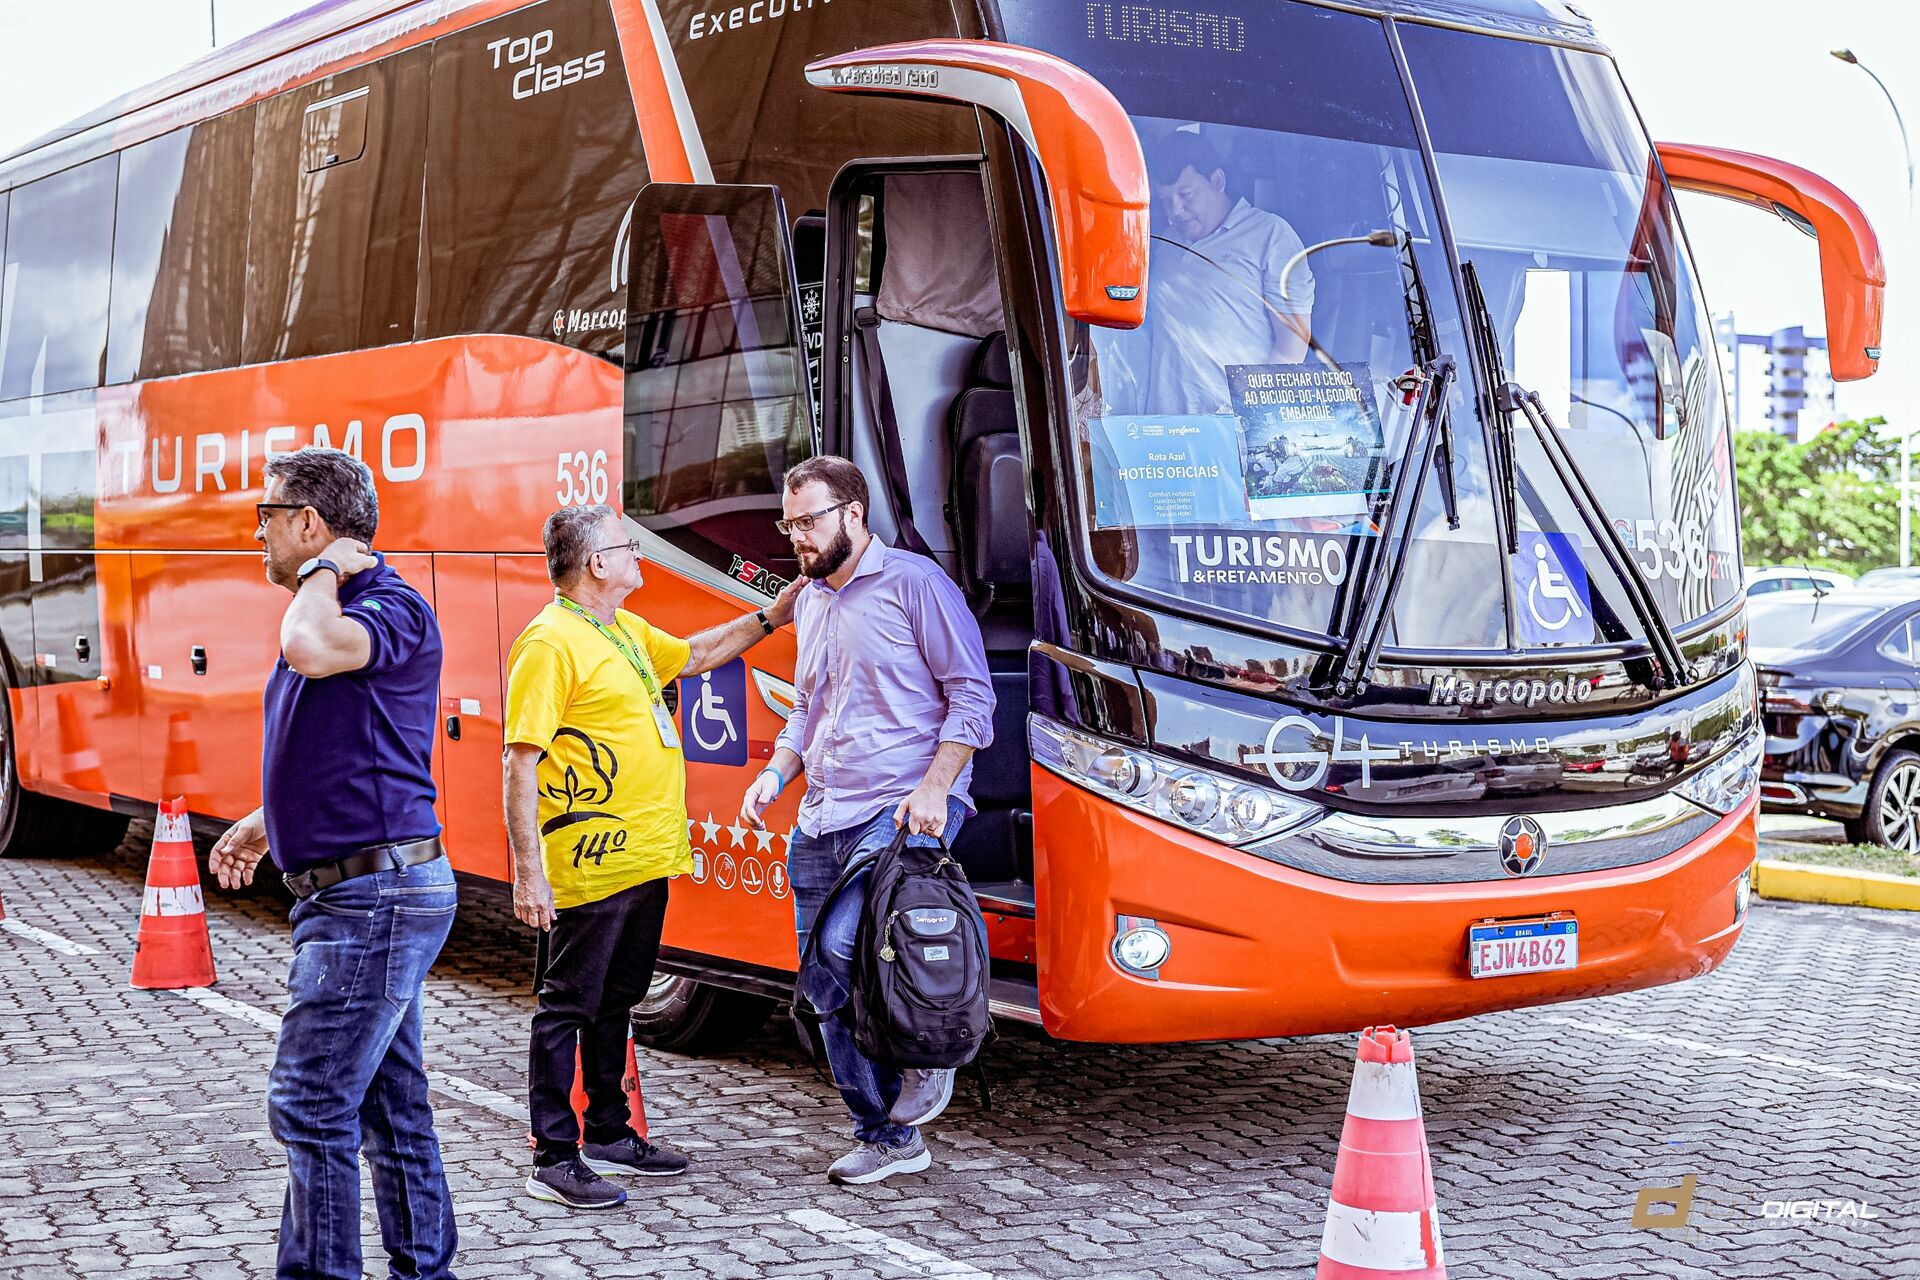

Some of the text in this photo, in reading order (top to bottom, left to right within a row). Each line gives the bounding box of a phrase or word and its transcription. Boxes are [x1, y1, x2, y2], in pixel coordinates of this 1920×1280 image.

[689, 0, 831, 40] Execu
[1087, 2, 1245, 52] TURISMO
[487, 29, 553, 70] Top
[512, 49, 606, 100] Class
[1244, 388, 1361, 404] AO BICUDO-DO-ALGODÃO?
[1247, 371, 1353, 388] QUER FECHAR O CERCO
[1280, 406, 1335, 421] EMBARQUE.
[1168, 425, 1200, 436] syngenta
[1119, 464, 1218, 480] HOTÉIS OFICIAIS
[1149, 452, 1186, 461] Rota Azul
[556, 449, 608, 506] 536
[1170, 535, 1347, 586] TURISMO
[1635, 519, 1708, 580] 536
[1193, 570, 1322, 585] &FRETAMENTO
[1429, 674, 1592, 708] Marcopolo
[1243, 715, 1550, 791] G4 TURISMO
[1515, 929, 1533, 937] BRASIL
[1481, 938, 1566, 971] EJW4B62
